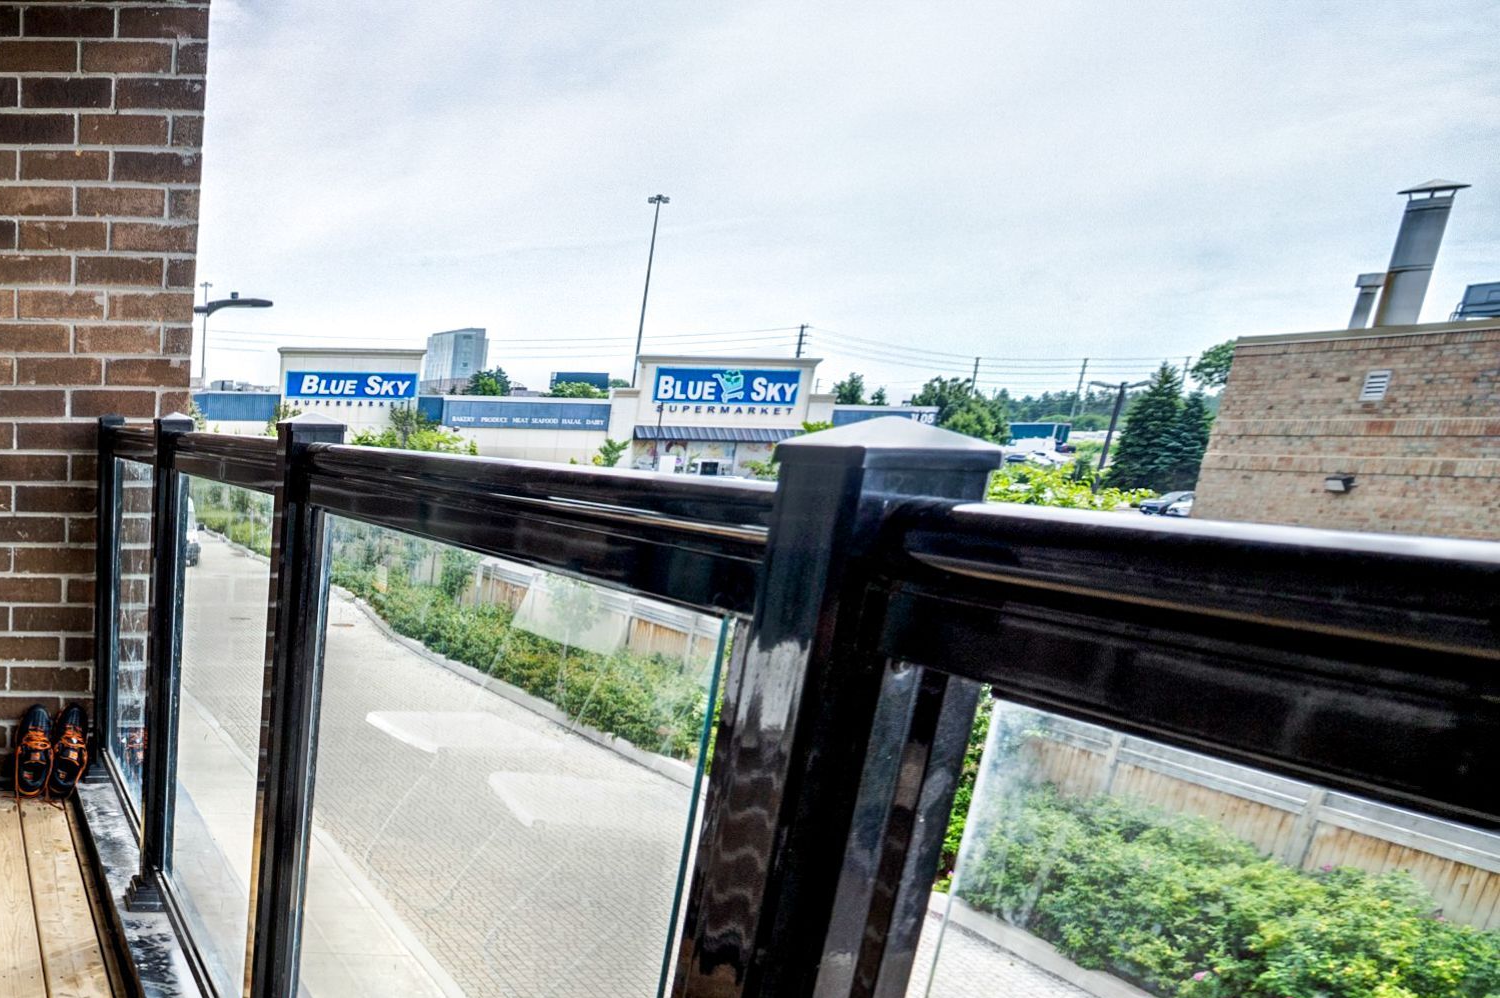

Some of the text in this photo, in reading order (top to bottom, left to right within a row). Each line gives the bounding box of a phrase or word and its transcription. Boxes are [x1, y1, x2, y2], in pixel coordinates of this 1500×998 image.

[300, 374, 410, 395] BLUE SKY
[657, 375, 798, 401] BLUE SKY
[294, 400, 405, 408] SUPERMARKET
[656, 404, 793, 415] SUPERMARKET
[480, 416, 508, 424] PRODUCE
[531, 417, 559, 425] SEAFOOD
[561, 418, 581, 426] HALAL
